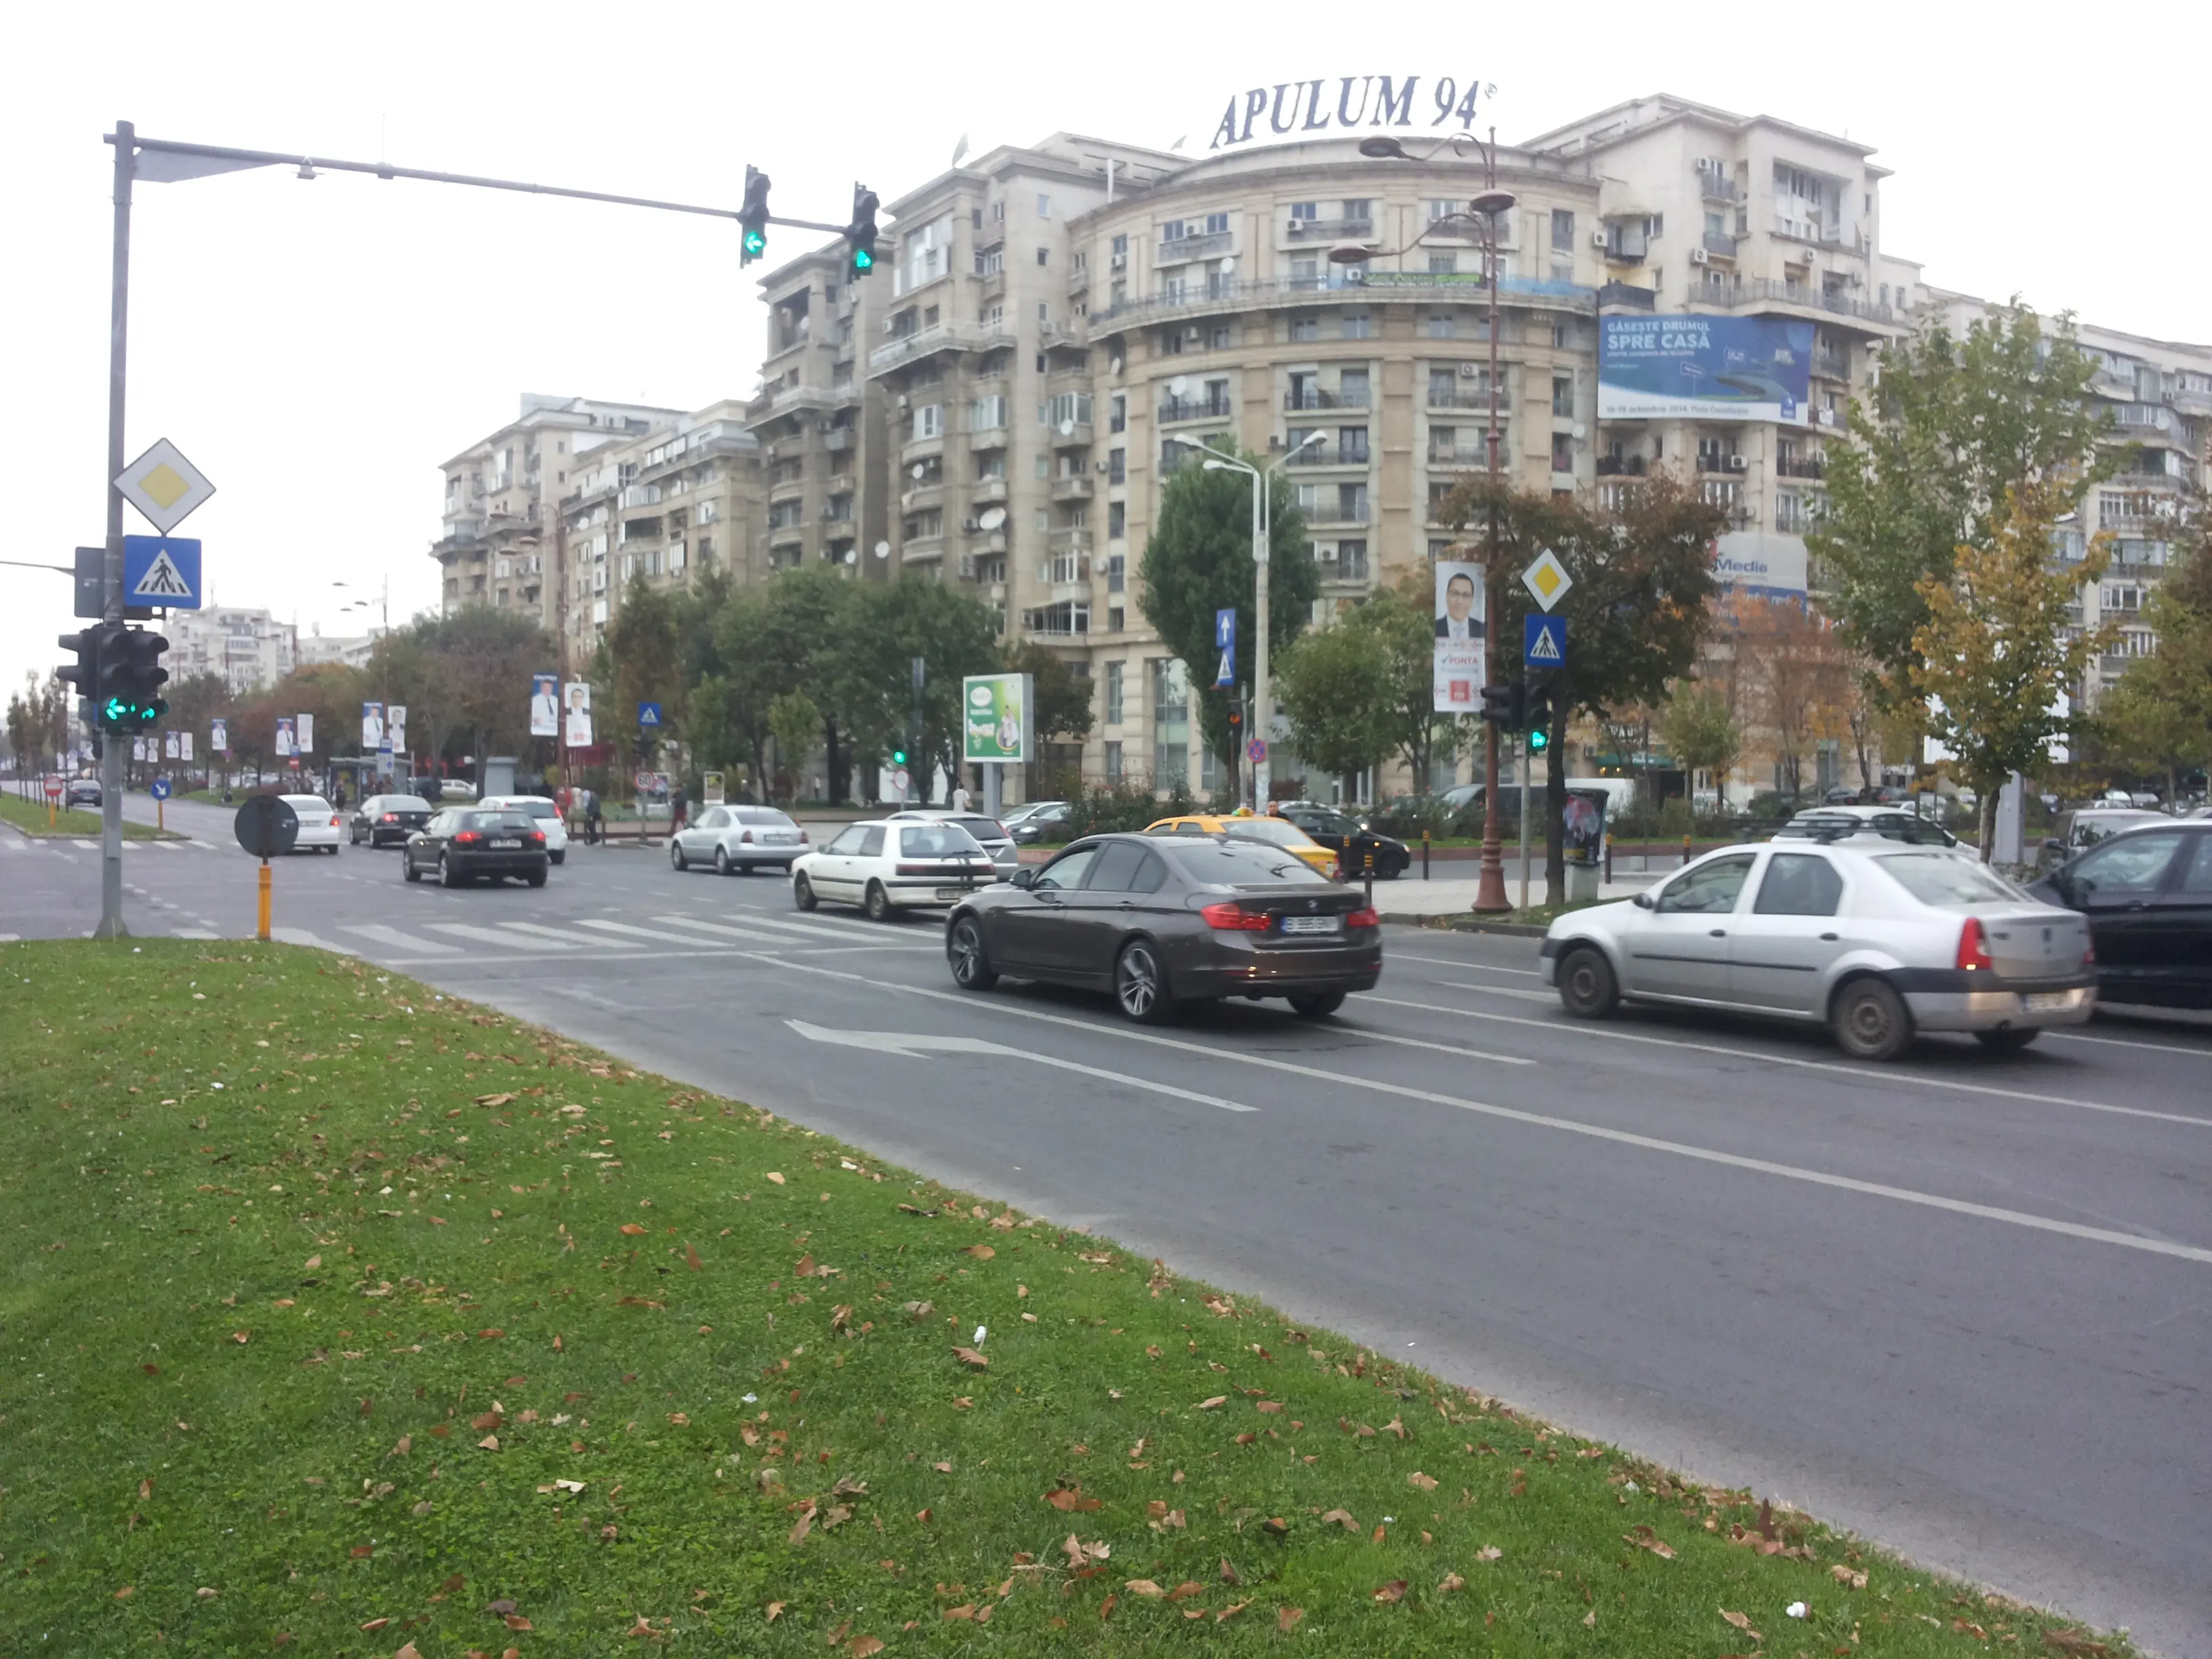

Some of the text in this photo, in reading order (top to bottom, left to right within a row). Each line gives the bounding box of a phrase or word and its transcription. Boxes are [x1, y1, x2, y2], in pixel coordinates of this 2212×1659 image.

[1209, 76, 1479, 149] APULUM 94
[1662, 321, 1711, 331] DRUMUL
[1607, 332, 1711, 349] SPRE CASĂ
[1715, 558, 1767, 573] Media
[1449, 656, 1478, 665] PONTA
[638, 774, 651, 784] 60
